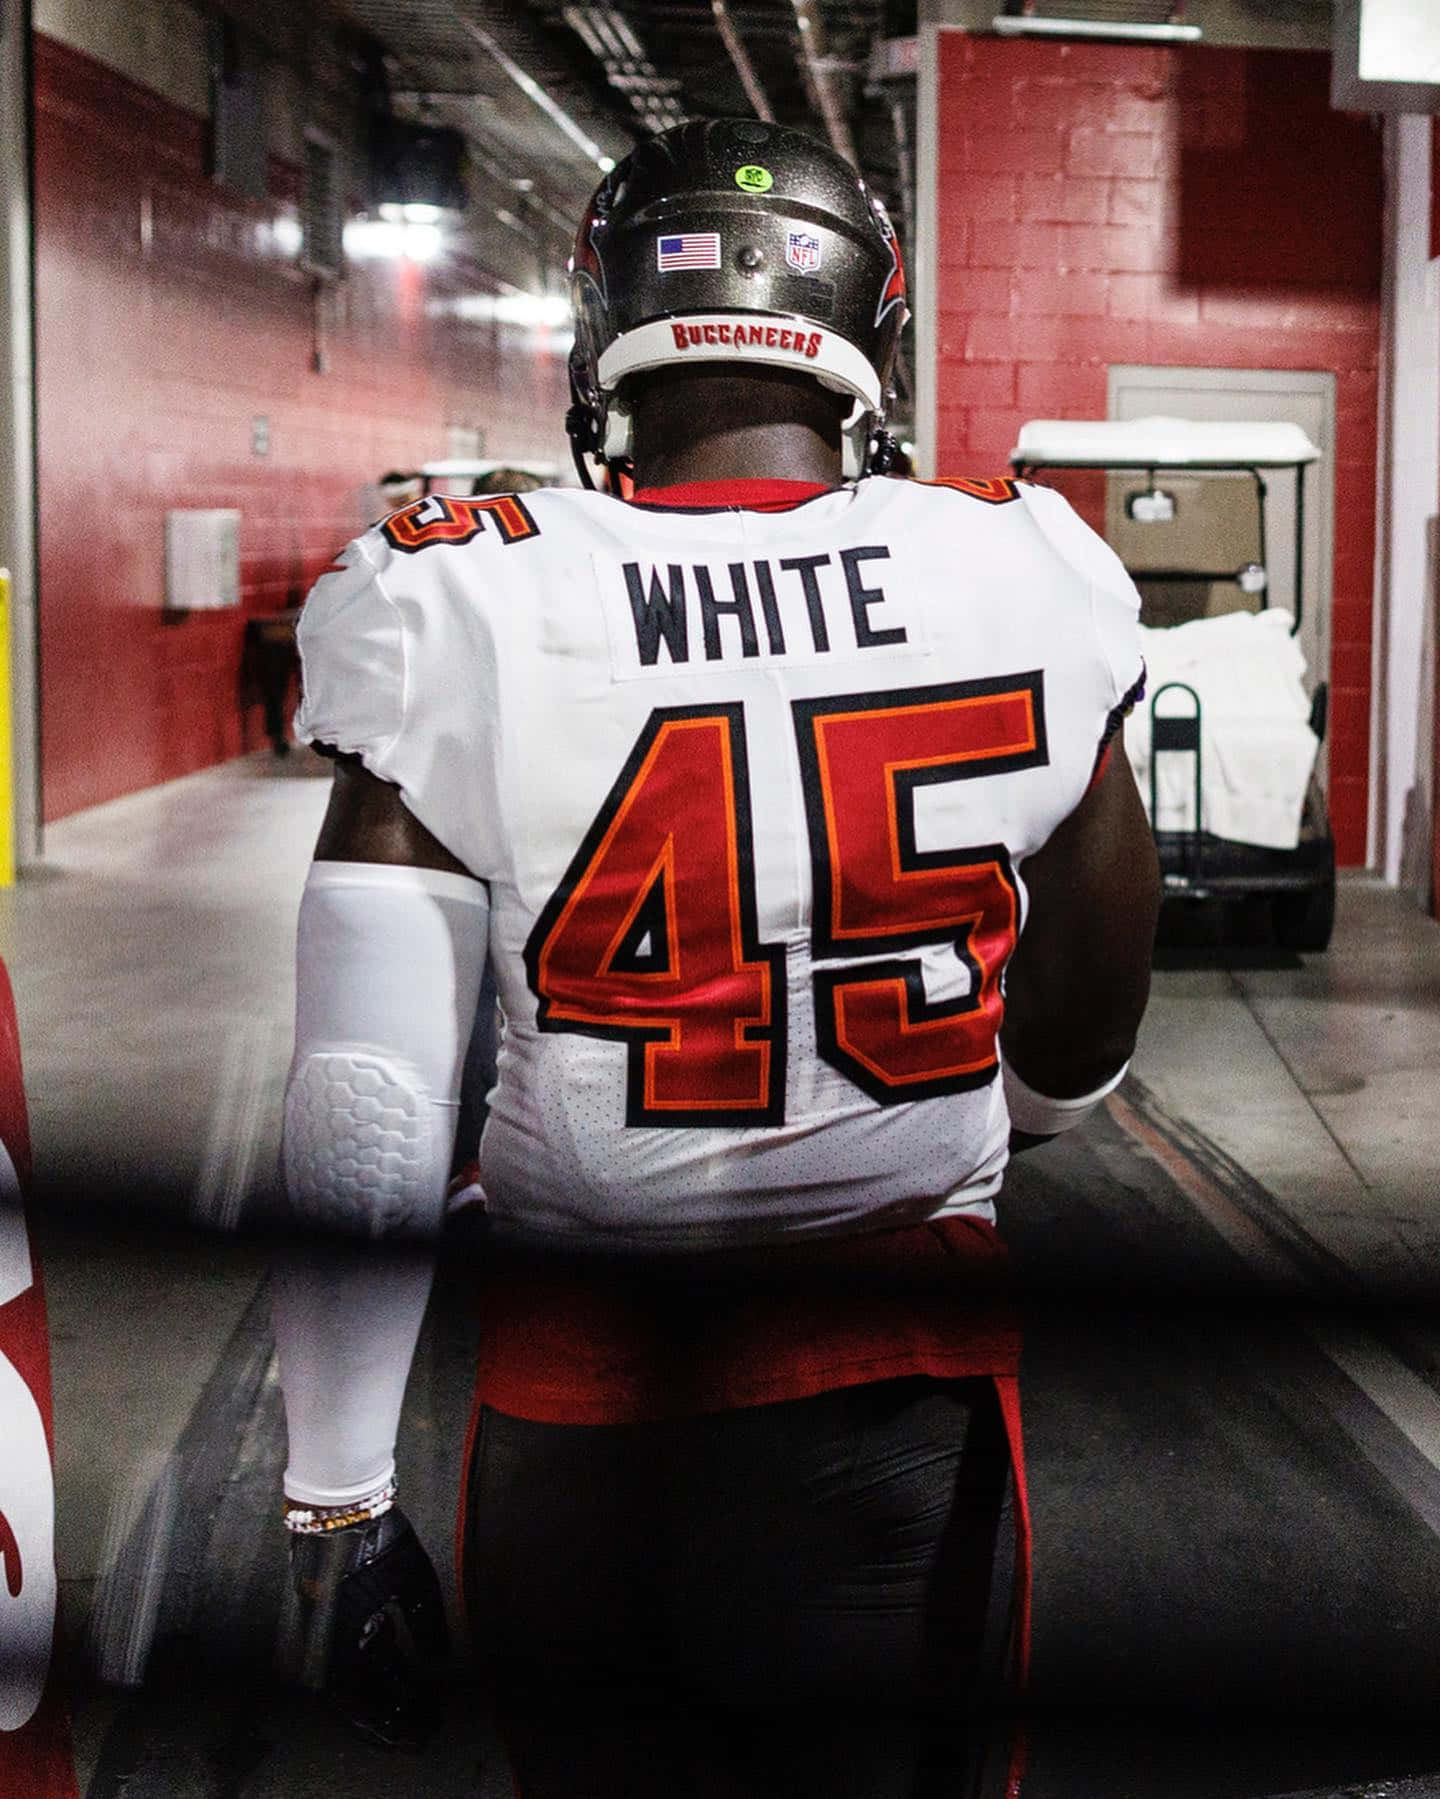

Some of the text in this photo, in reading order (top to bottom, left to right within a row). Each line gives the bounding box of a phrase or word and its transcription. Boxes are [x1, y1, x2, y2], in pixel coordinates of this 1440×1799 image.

[791, 247, 815, 266] NFL
[671, 323, 823, 358] BUCCANEERS
[622, 546, 908, 666] WHITE
[522, 669, 1050, 1128] 45
